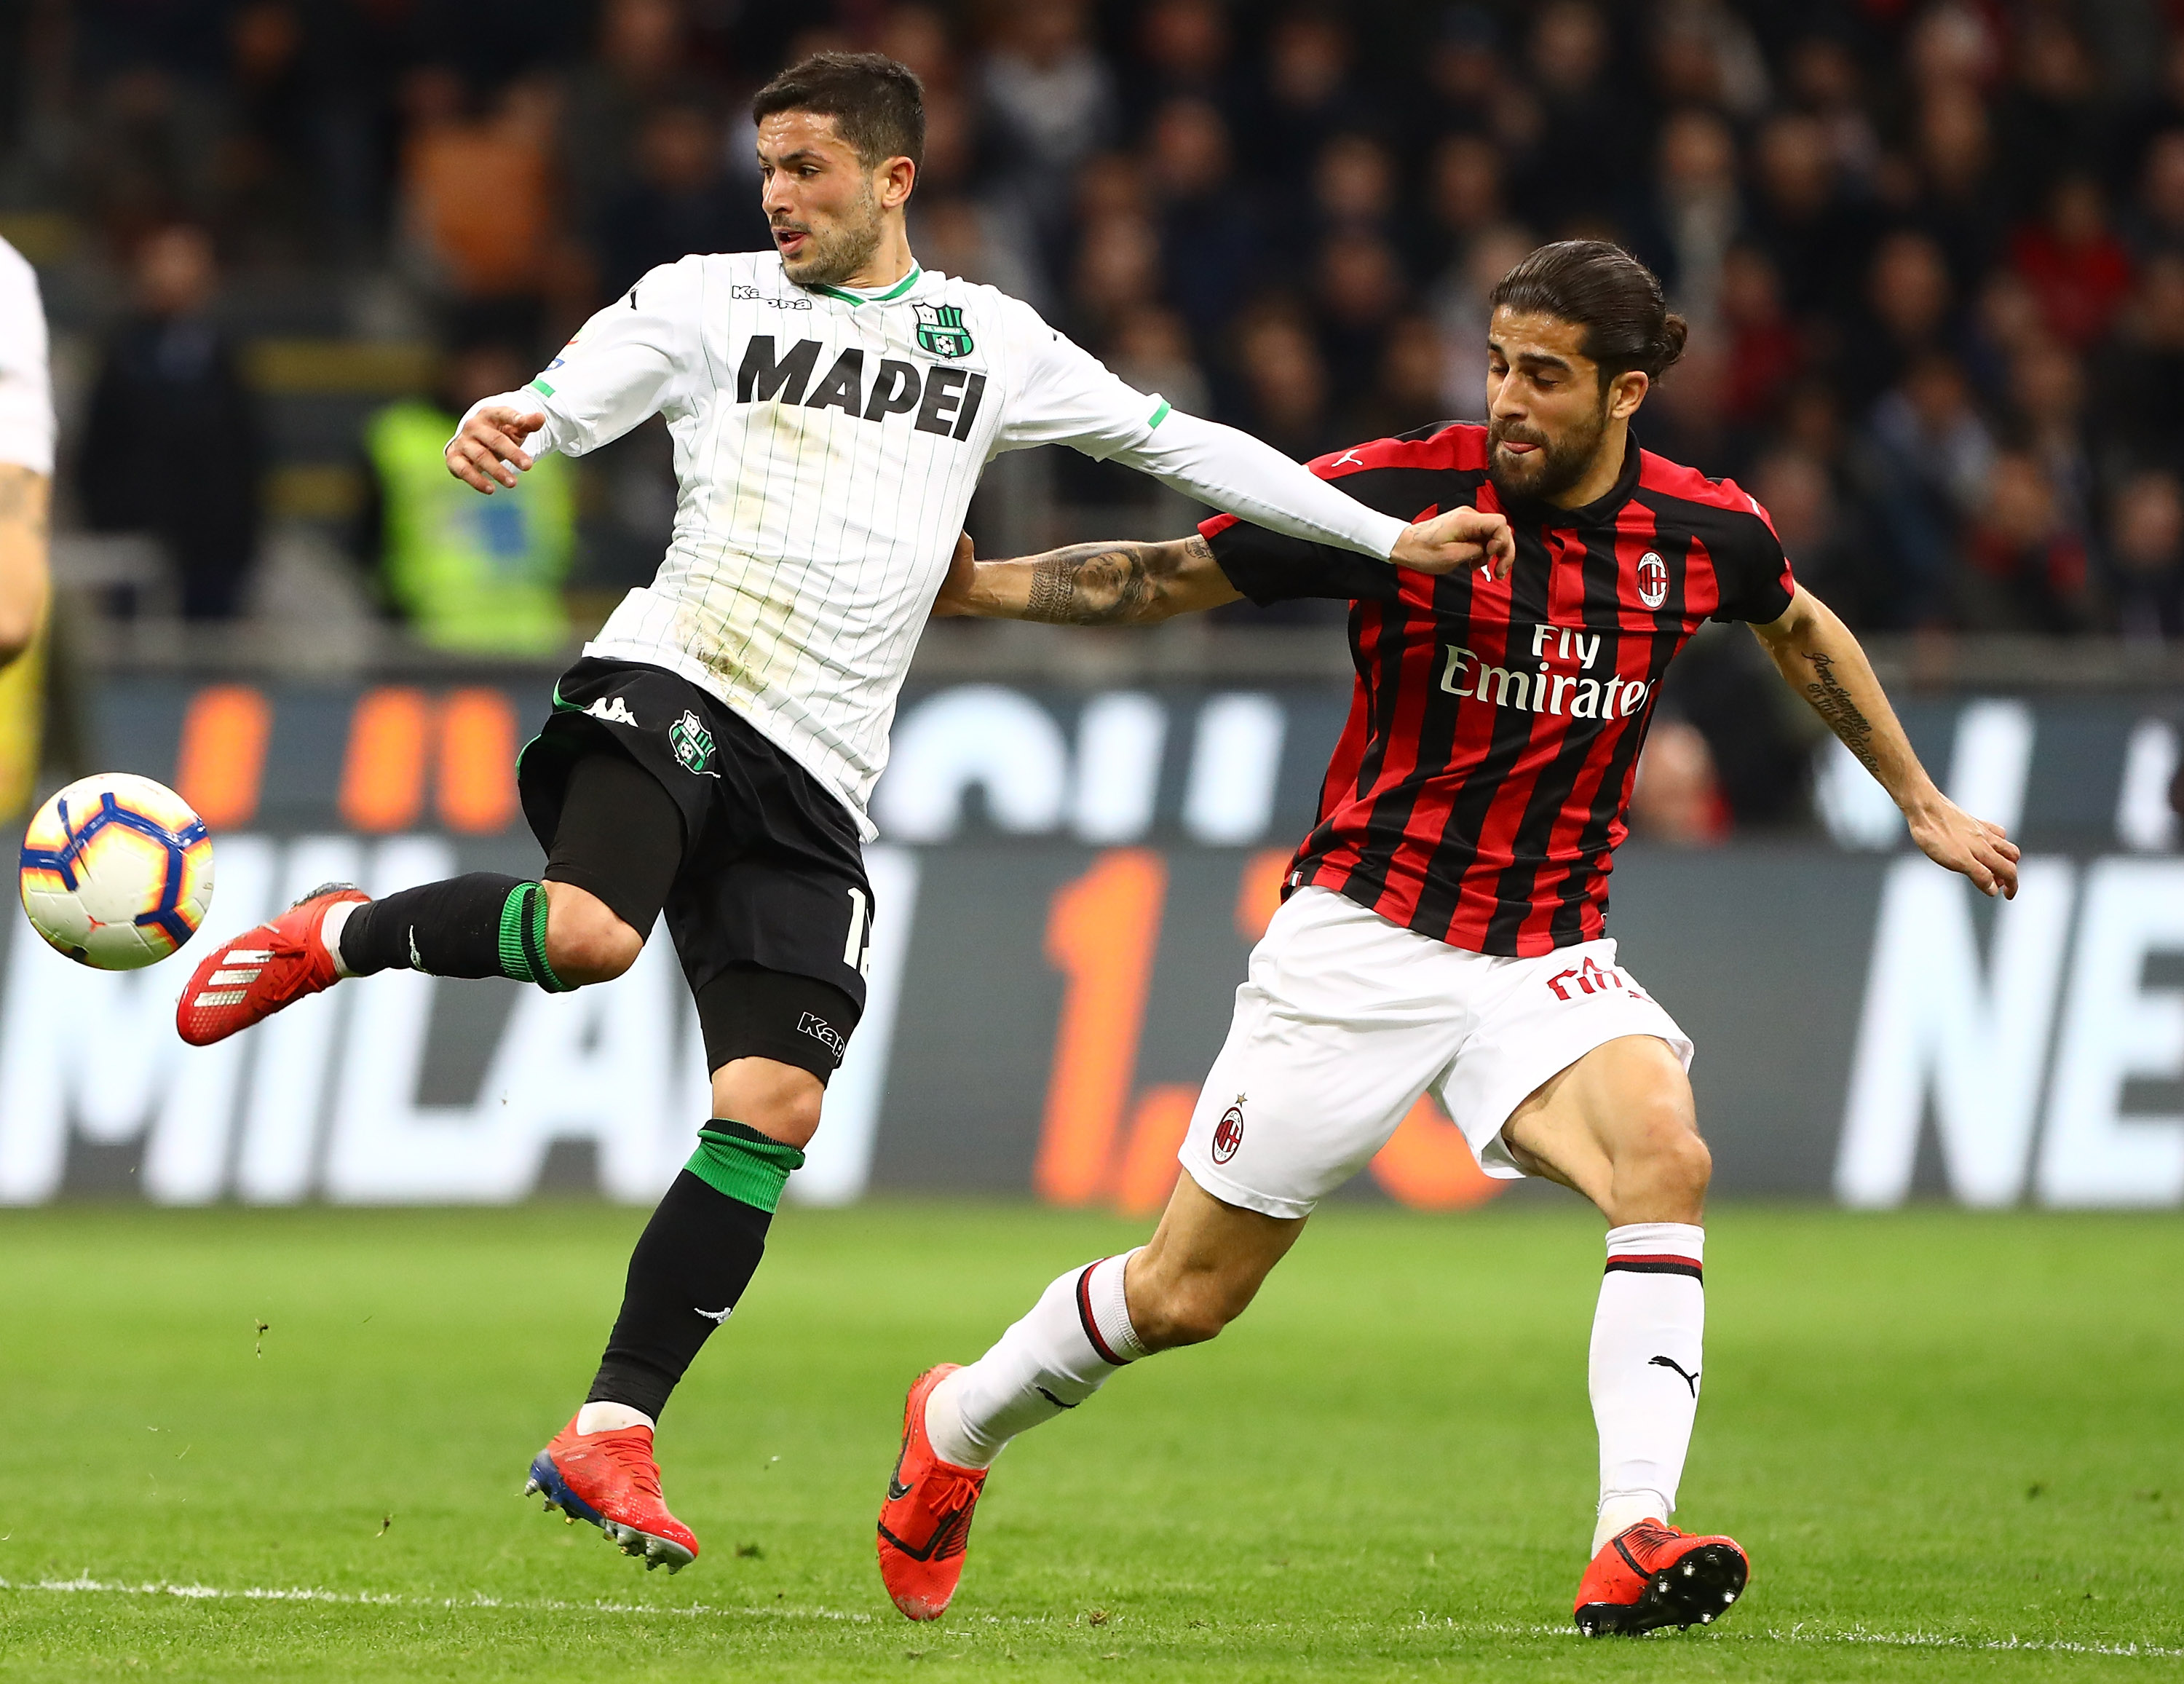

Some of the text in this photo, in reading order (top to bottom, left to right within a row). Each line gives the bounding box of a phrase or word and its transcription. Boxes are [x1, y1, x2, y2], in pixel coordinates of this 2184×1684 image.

[737, 335, 986, 442] MAPEI
[1642, 554, 1661, 565] ACM
[1532, 624, 1600, 669] Fly
[842, 886, 871, 980] 1
